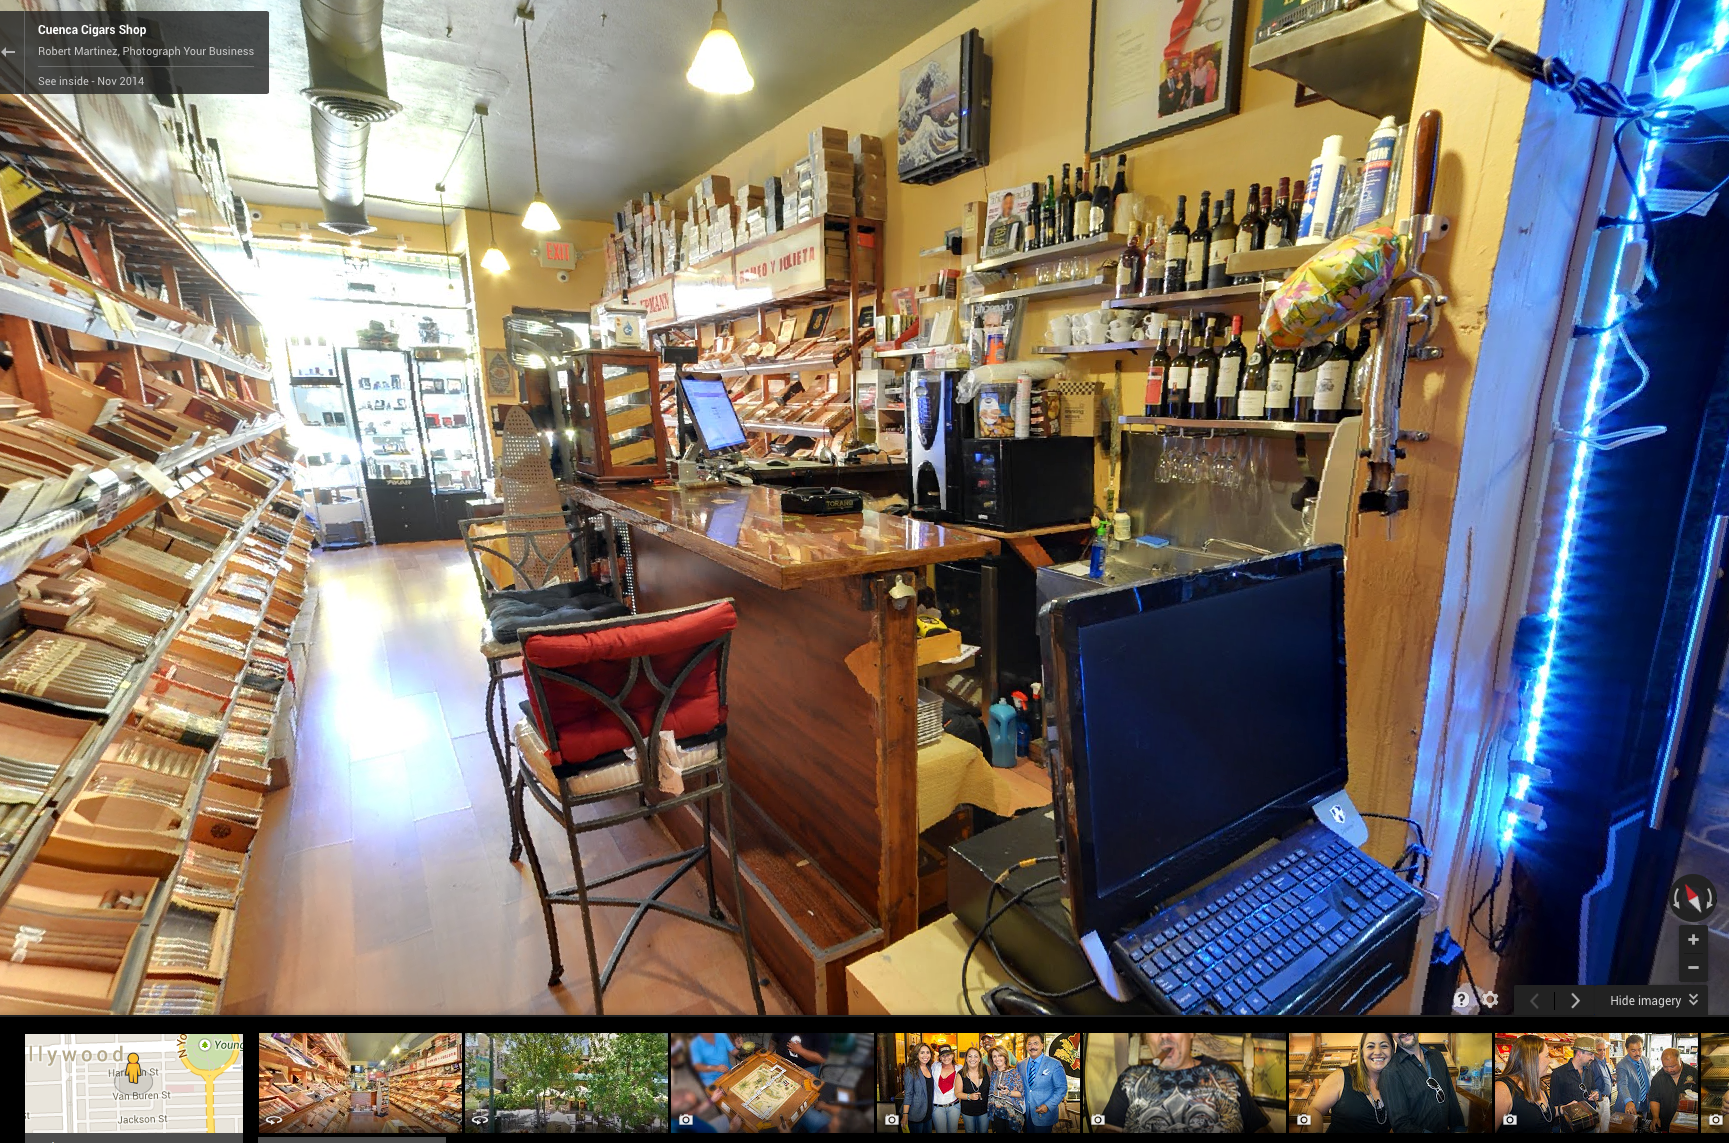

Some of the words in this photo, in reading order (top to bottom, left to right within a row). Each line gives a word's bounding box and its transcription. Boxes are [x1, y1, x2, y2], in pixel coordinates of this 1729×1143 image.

[546, 241, 570, 261] EXIT
[770, 259, 776, 274] Y
[779, 245, 815, 273] JULIETA
